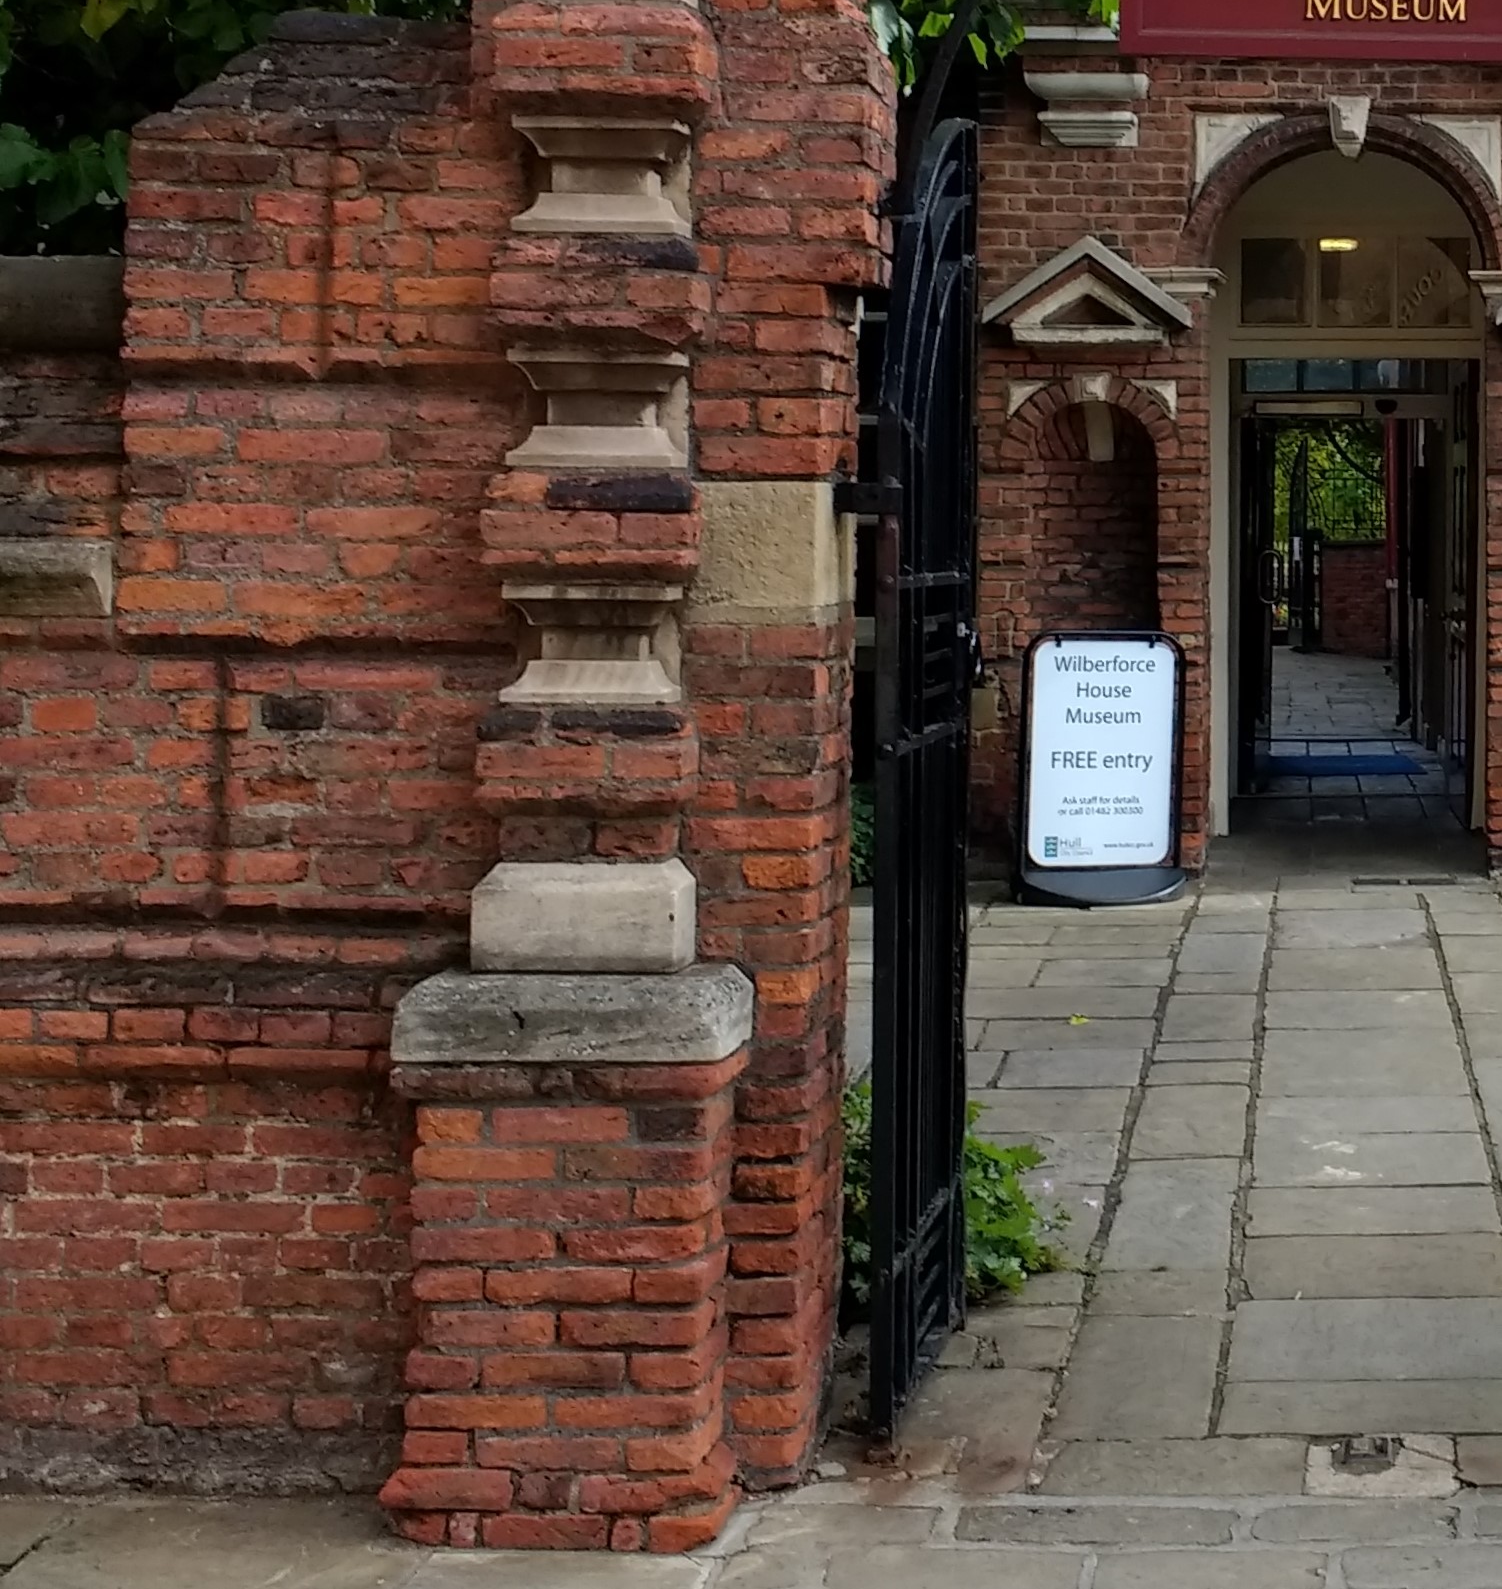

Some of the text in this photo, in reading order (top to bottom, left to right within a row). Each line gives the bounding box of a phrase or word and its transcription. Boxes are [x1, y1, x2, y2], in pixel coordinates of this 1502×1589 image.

[1054, 655, 1156, 673] Wilberforce
[1076, 682, 1132, 699] House
[1065, 708, 1142, 724] Museum
[1051, 751, 1153, 773] FREE entry
[1062, 795, 1140, 804] Ask staff for details
[1069, 807, 1084, 816] call
[1060, 837, 1082, 848] Hull
